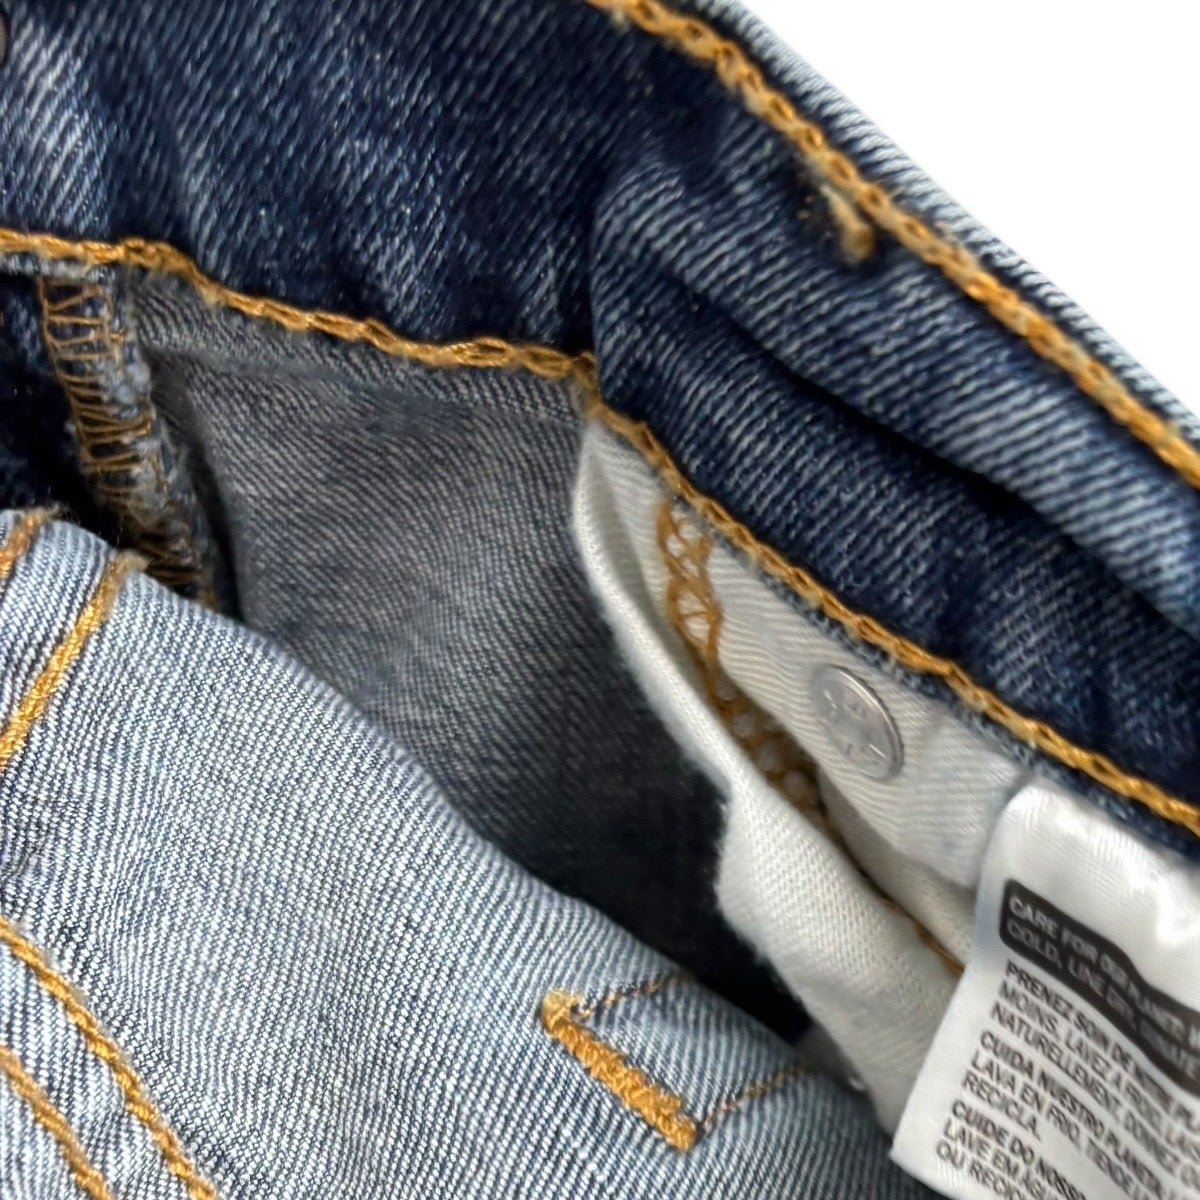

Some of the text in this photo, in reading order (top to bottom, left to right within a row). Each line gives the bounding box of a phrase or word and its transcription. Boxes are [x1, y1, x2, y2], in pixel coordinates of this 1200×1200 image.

[1012, 895, 1056, 938] CARE
[1007, 960, 1073, 1019] PRENEZ
[1074, 1010, 1108, 1051] SOIN
[1113, 1042, 1130, 1071] DE
[973, 1051, 1016, 1093] LAVA
[1023, 1083, 1045, 1113] EN
[982, 1030, 1033, 1079] CUIDA
[1043, 1070, 1104, 1138] NUESTRO
[1068, 1028, 1109, 1080] LAVEZ
[939, 1139, 965, 1169] OU
[945, 1118, 988, 1159] LAVE
[993, 1149, 1019, 1180] EM
[953, 1099, 1008, 1146] CUIDE
[1011, 1136, 1033, 1165] DO
